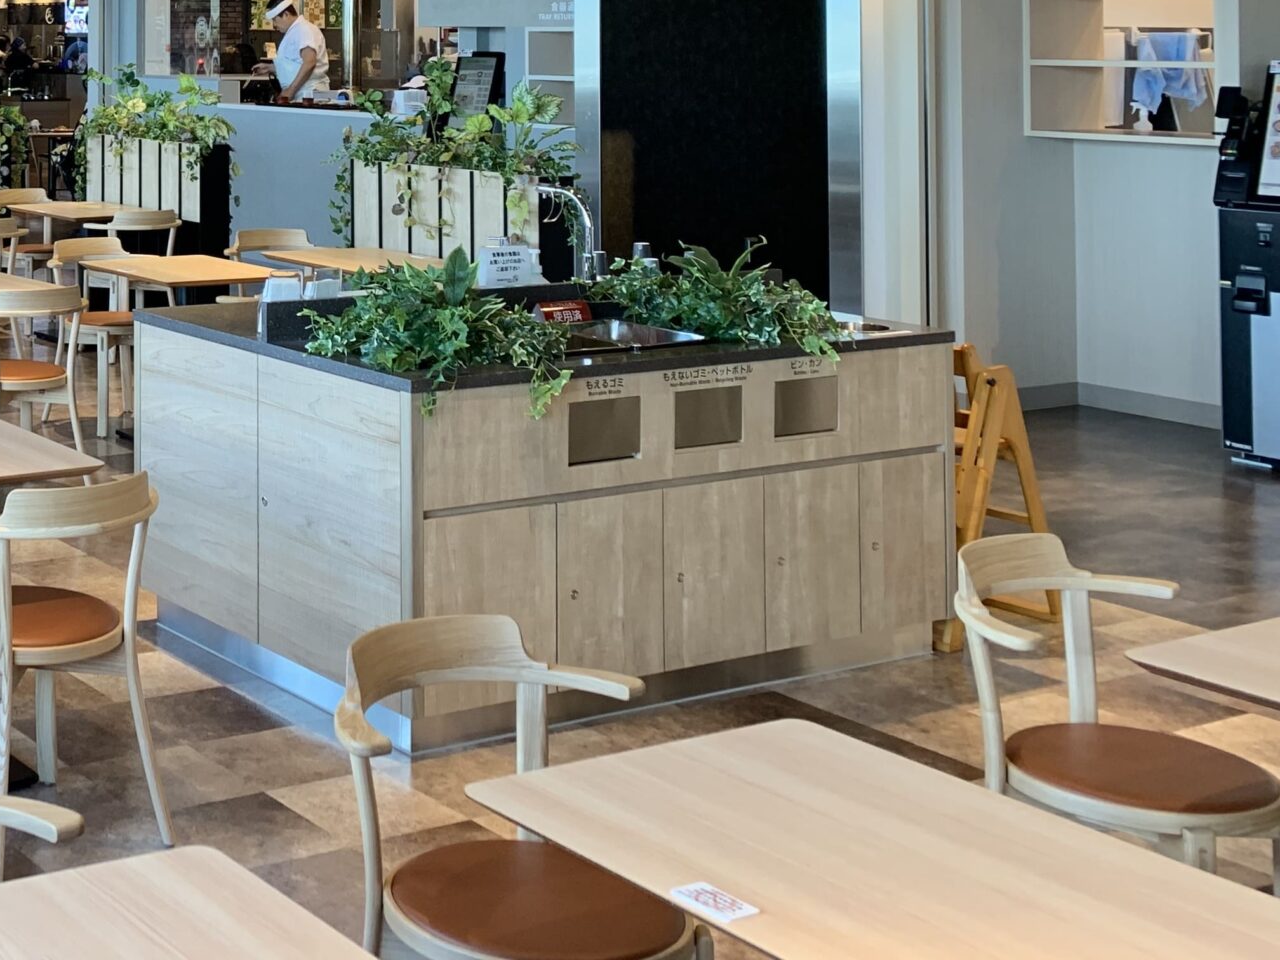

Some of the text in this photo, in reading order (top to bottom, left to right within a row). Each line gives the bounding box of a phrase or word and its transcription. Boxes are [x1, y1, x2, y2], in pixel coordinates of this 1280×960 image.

[553, 309, 583, 322] 使用済
[586, 377, 625, 390] もえるゴミ
